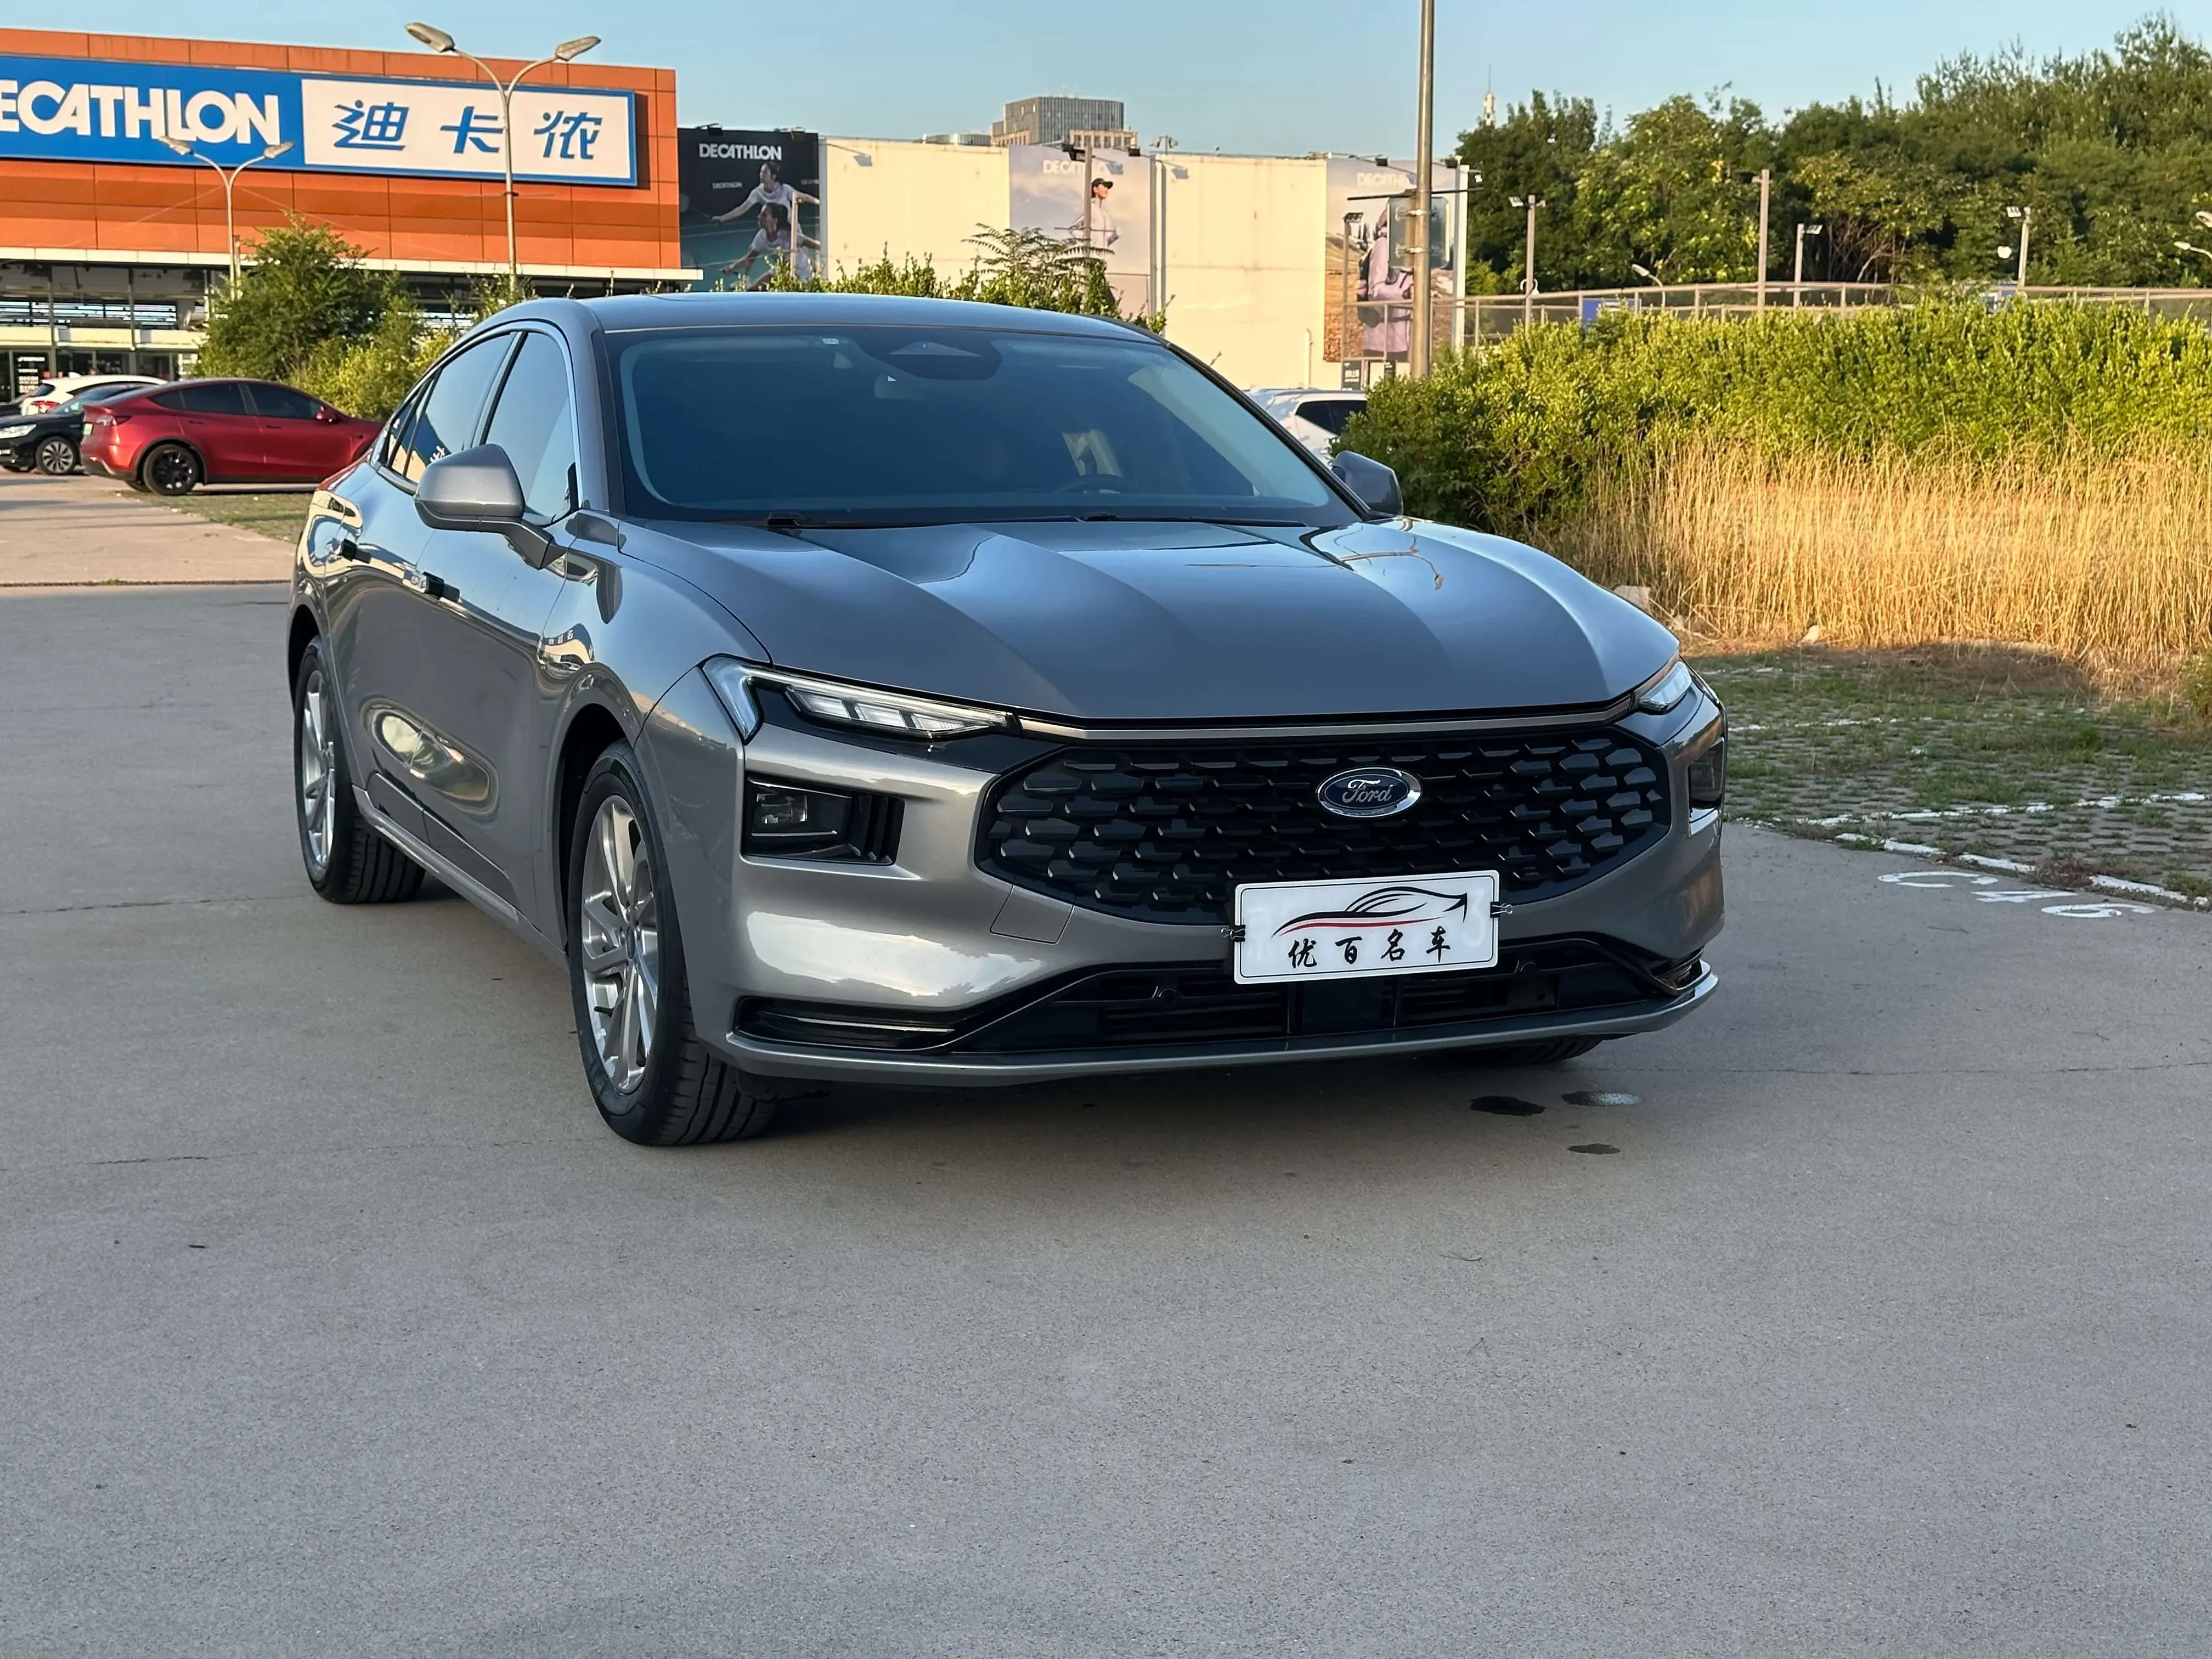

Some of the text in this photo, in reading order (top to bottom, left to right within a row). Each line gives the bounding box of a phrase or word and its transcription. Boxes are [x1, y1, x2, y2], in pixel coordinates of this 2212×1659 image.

[331, 100, 603, 160] 迪卡侬
[698, 143, 782, 161] DECATHLON
[1341, 778, 1393, 804] Ford
[1287, 925, 1451, 969] 优百名车
